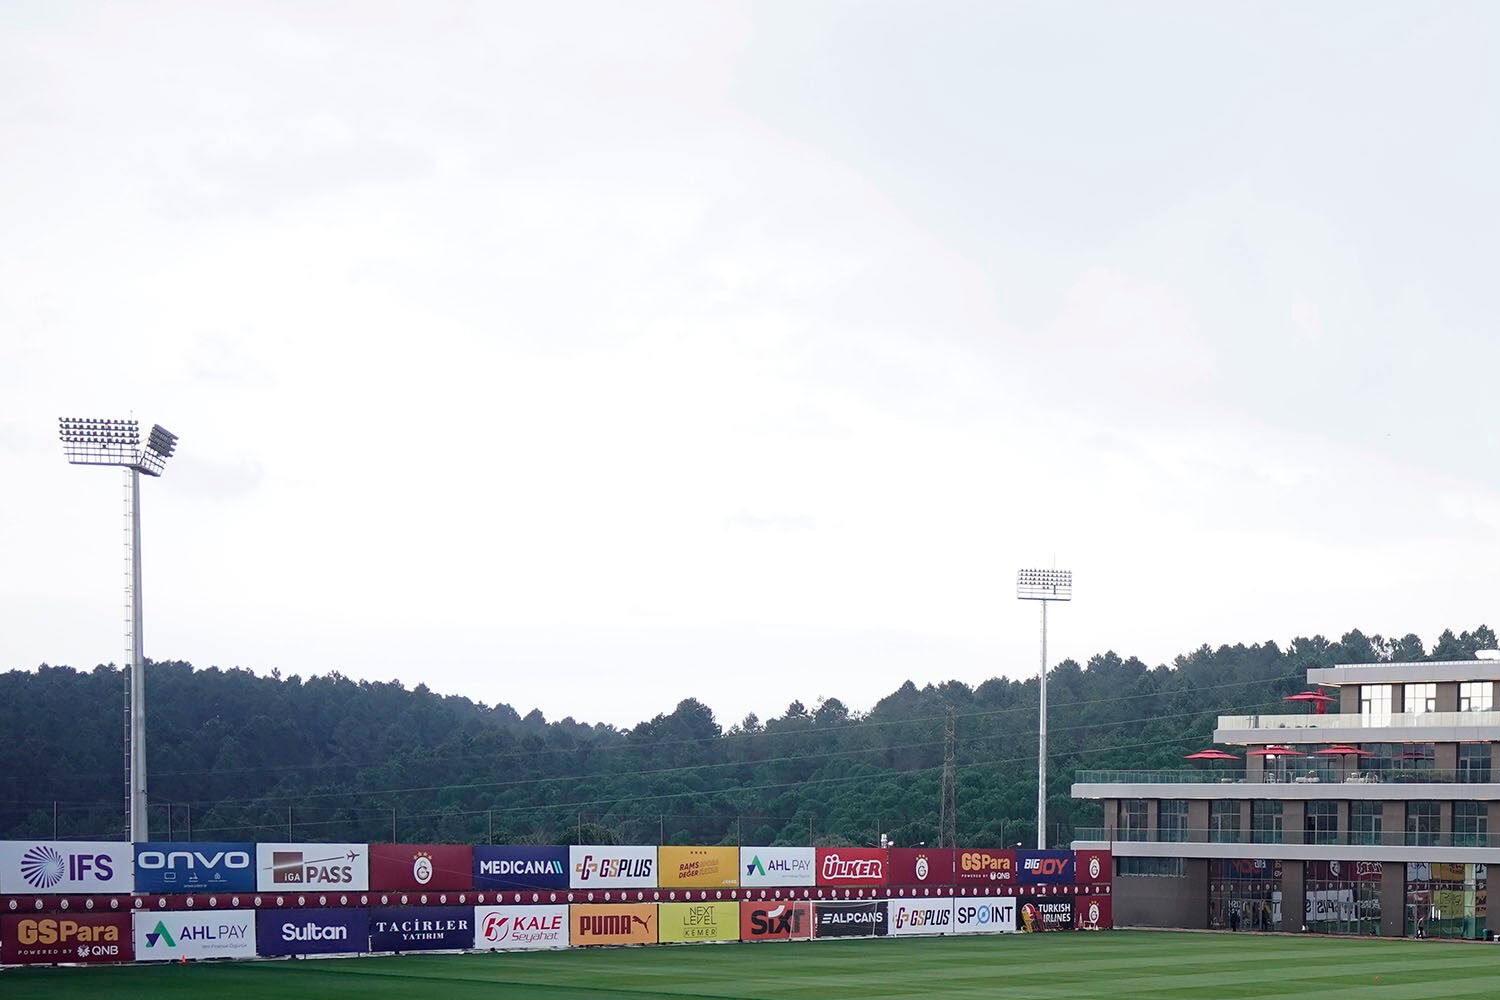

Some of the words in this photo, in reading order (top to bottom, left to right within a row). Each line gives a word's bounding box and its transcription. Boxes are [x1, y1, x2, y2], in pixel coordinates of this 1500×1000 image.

[69, 854, 113, 881] IFS
[480, 860, 555, 875] MEDICANA
[679, 861, 700, 871] RAMS
[822, 854, 882, 880] ÜLKER
[306, 866, 353, 883] PASS
[996, 872, 1011, 880] QNB
[690, 906, 715, 916] NEXT
[1038, 904, 1071, 913] TURKISH
[513, 916, 562, 930] KALE
[684, 915, 717, 926] LEVEL
[832, 912, 883, 924] ALPCANS
[1043, 913, 1071, 923] IRLINES
[282, 922, 347, 940] Sultan
[376, 918, 468, 932] TACİRLER
[580, 915, 631, 936] PUMA
[402, 932, 444, 940] YATIRIM
[511, 932, 559, 944] Seyahat
[92, 945, 119, 956] QNB
